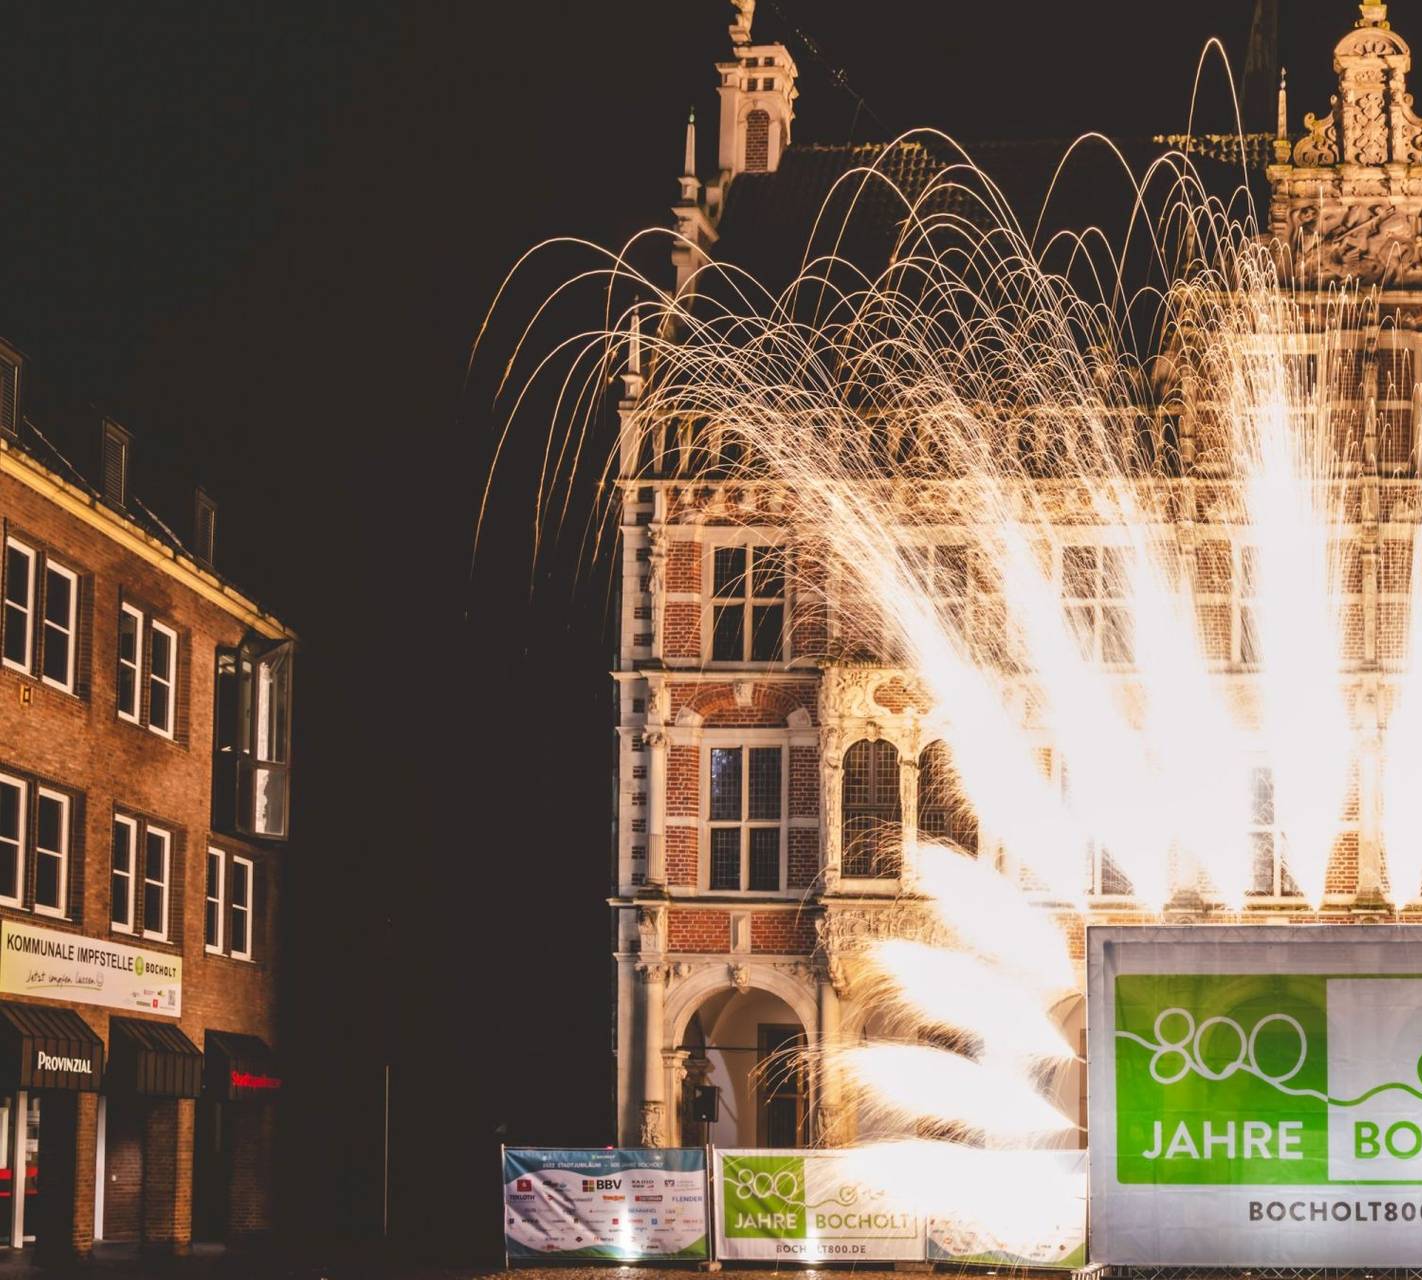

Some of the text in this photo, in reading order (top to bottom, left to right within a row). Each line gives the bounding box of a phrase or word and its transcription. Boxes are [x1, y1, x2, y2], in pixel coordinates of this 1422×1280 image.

[7, 933, 133, 971] KOMMUNALE IMPFSTELLE
[145, 962, 176, 977] BOCHOLT
[1142, 1121, 1303, 1159] JAHRE
[596, 1179, 622, 1190] BBV
[734, 1213, 908, 1230] JAHRE BOCHOLT
[776, 1244, 866, 1254] BOCHLT800.DE
